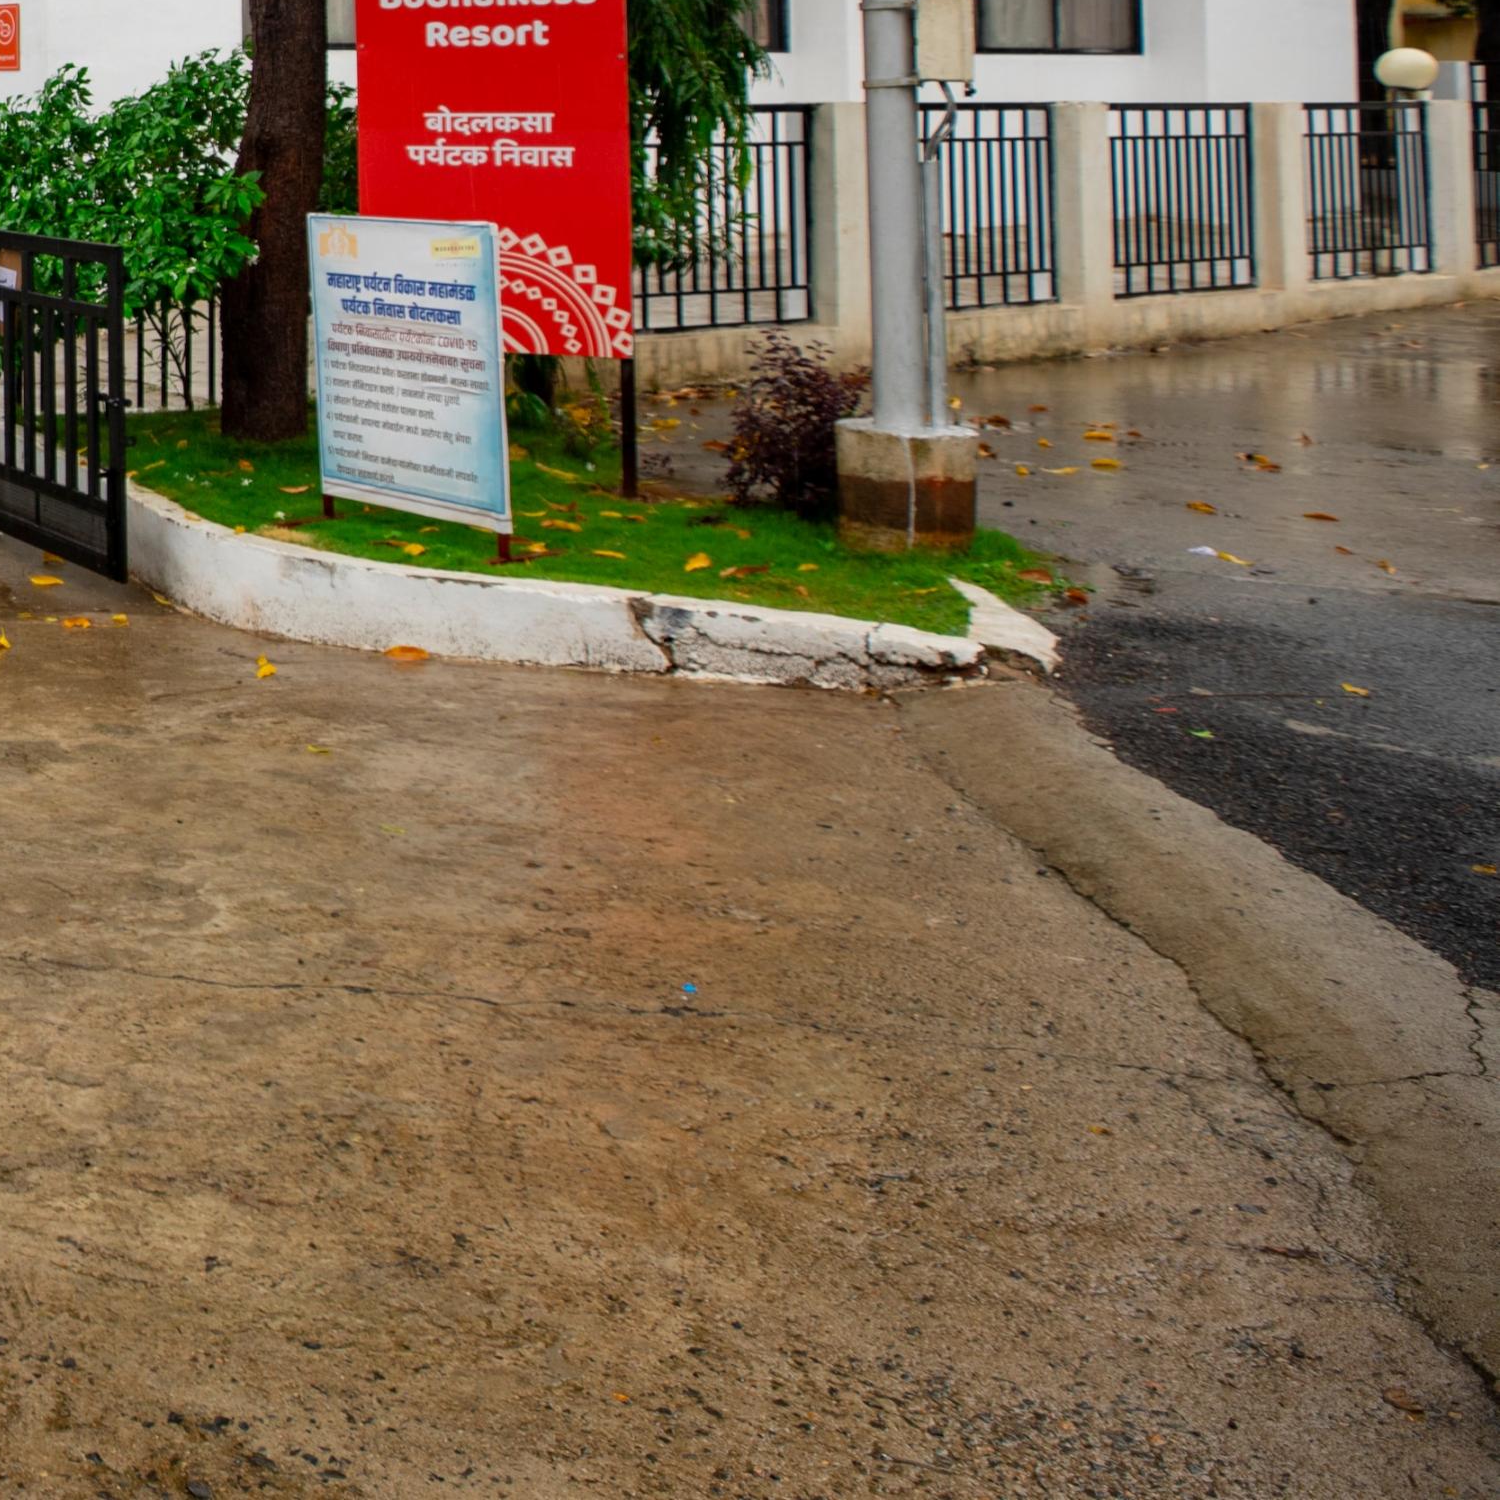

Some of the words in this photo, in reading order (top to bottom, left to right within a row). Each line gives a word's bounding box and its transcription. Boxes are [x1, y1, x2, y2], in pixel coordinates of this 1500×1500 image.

[426, 19, 550, 48] Resort
[423, 104, 555, 134] बोदलकसा
[406, 139, 488, 167] पर्यटक
[493, 139, 575, 167] निवास
[363, 271, 392, 293] पर्यटन
[394, 273, 426, 296] विकास
[428, 278, 477, 302] महामंडळ
[341, 295, 371, 316] पर्यटक
[372, 298, 406, 319] निवास
[408, 301, 462, 326] बोदलकसा
